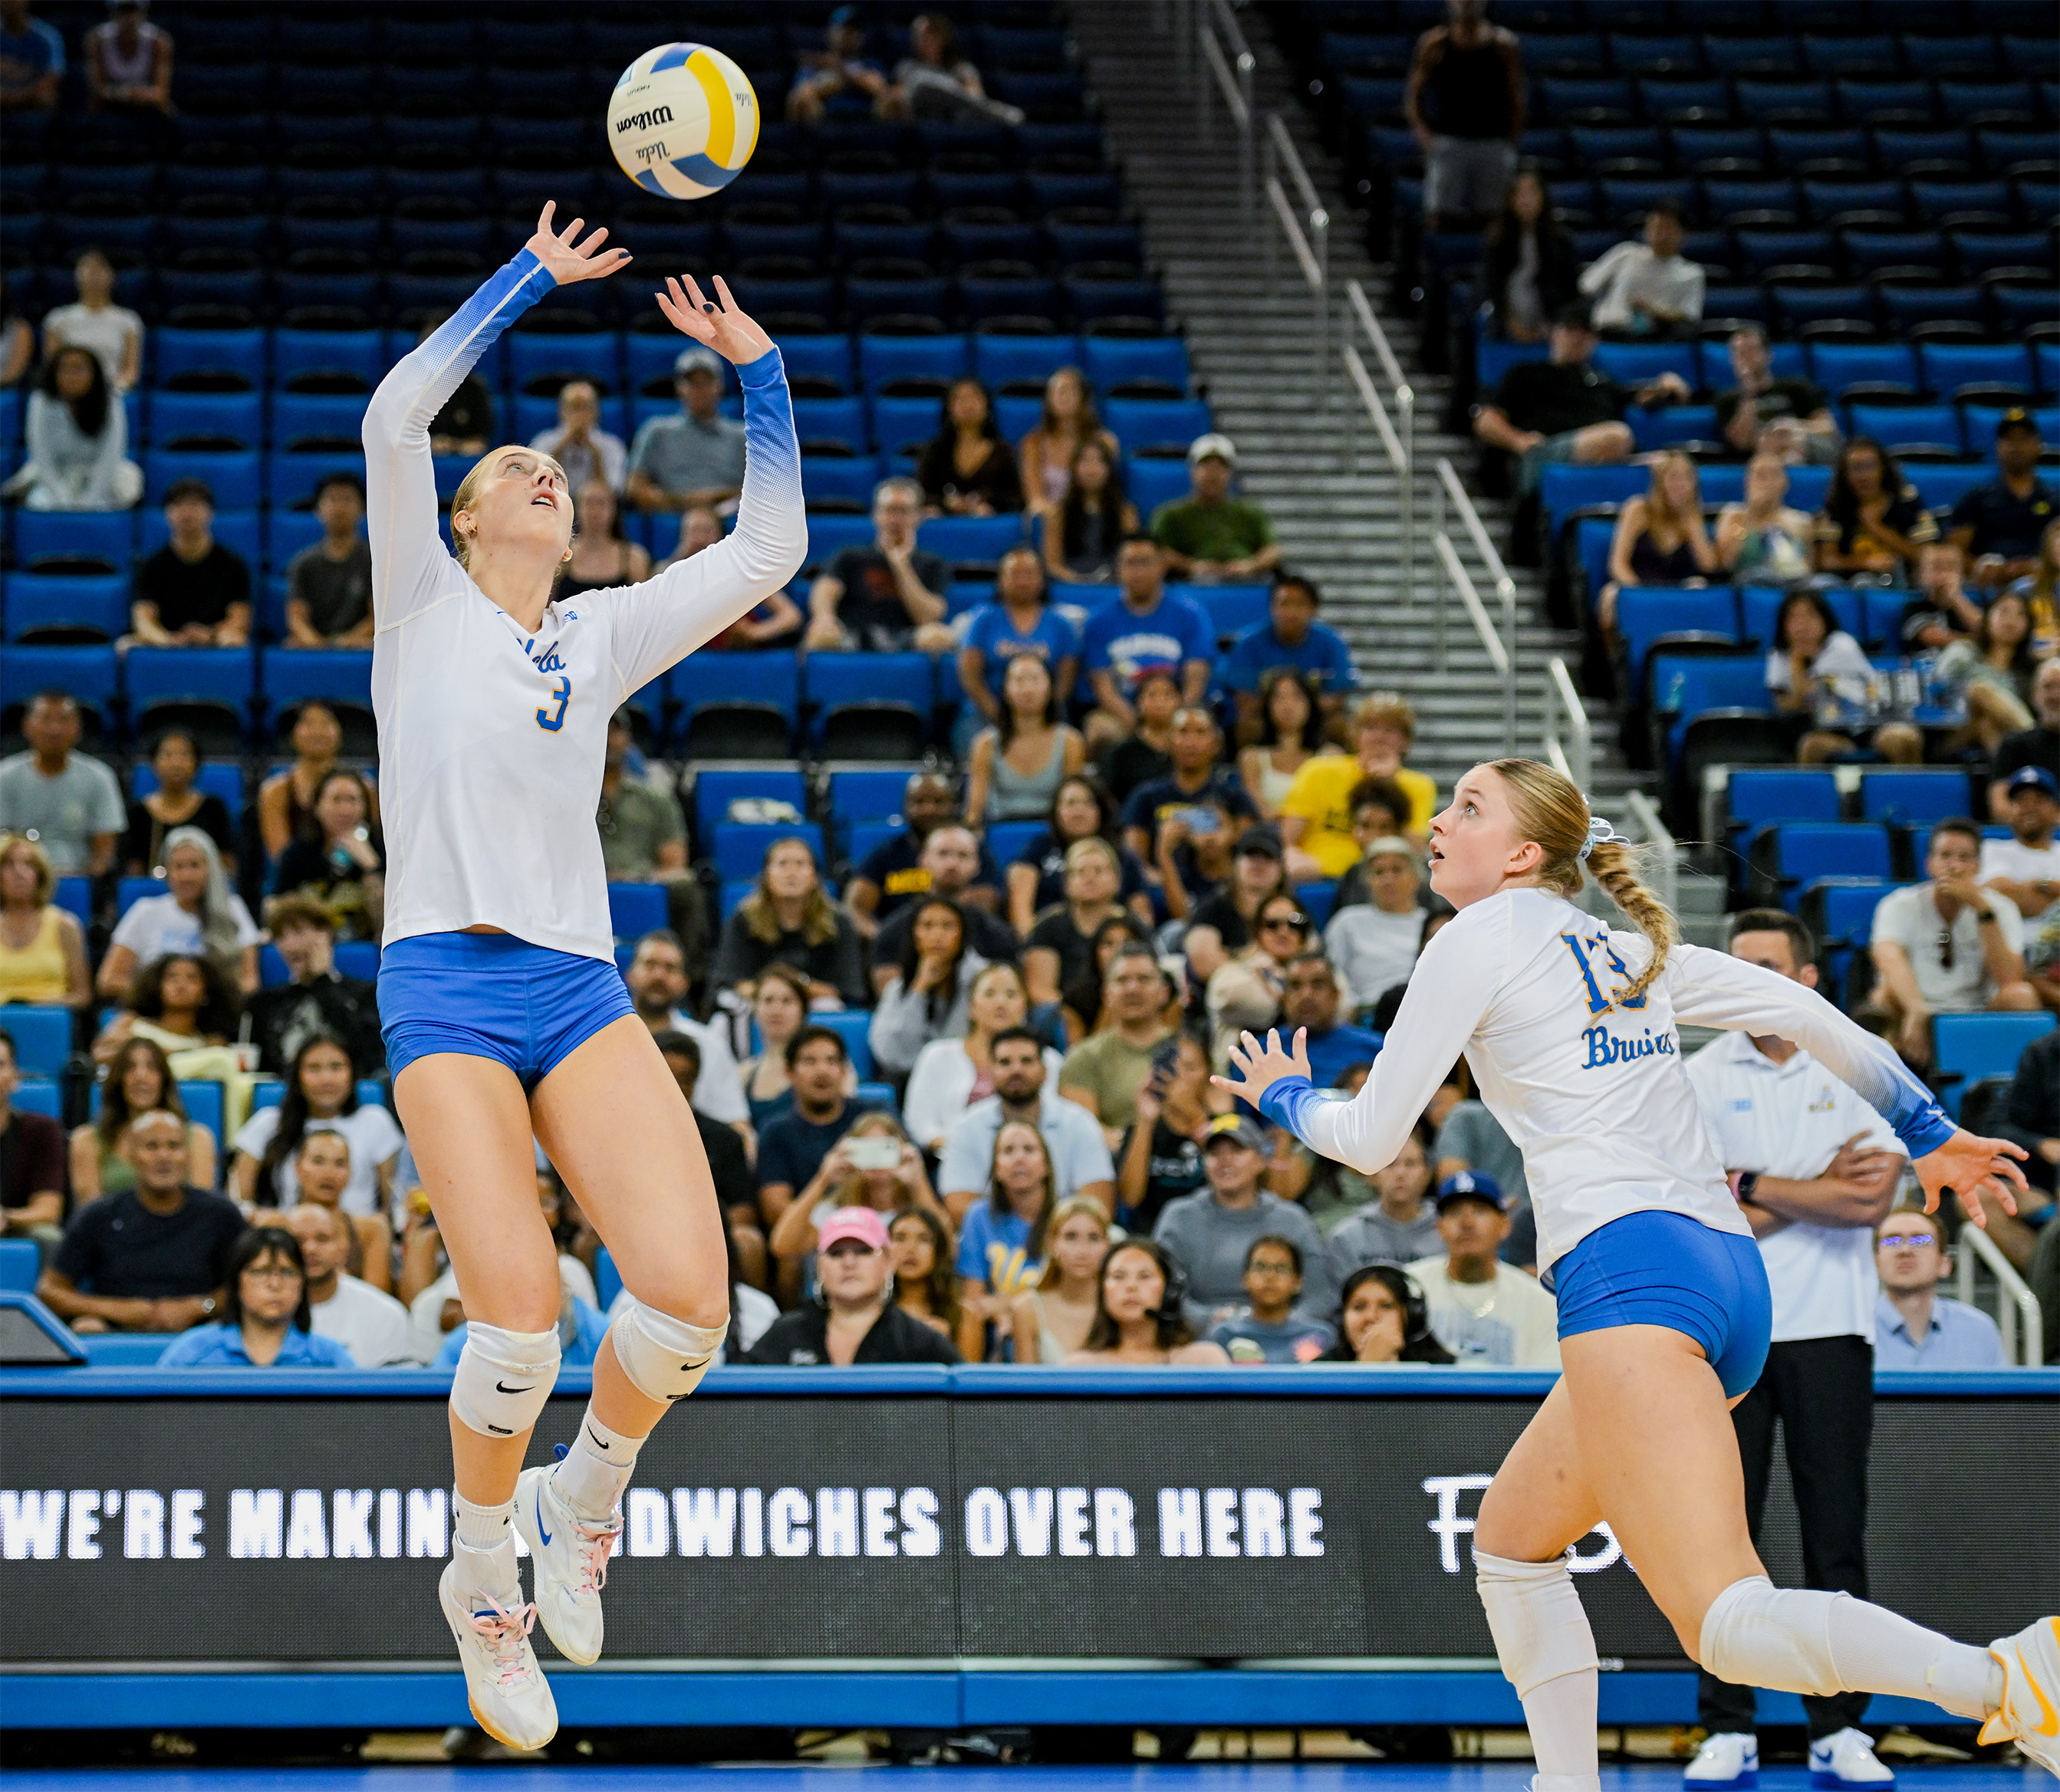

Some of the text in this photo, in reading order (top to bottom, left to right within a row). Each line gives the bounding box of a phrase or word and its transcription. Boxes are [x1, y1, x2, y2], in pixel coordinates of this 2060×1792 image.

[616, 106, 674, 134] Wilson
[534, 675, 573, 735] 3
[1560, 930, 1650, 1017] 13
[0, 1487, 1326, 1559] WE'RE MAKIN DWICHES OVER HERE
